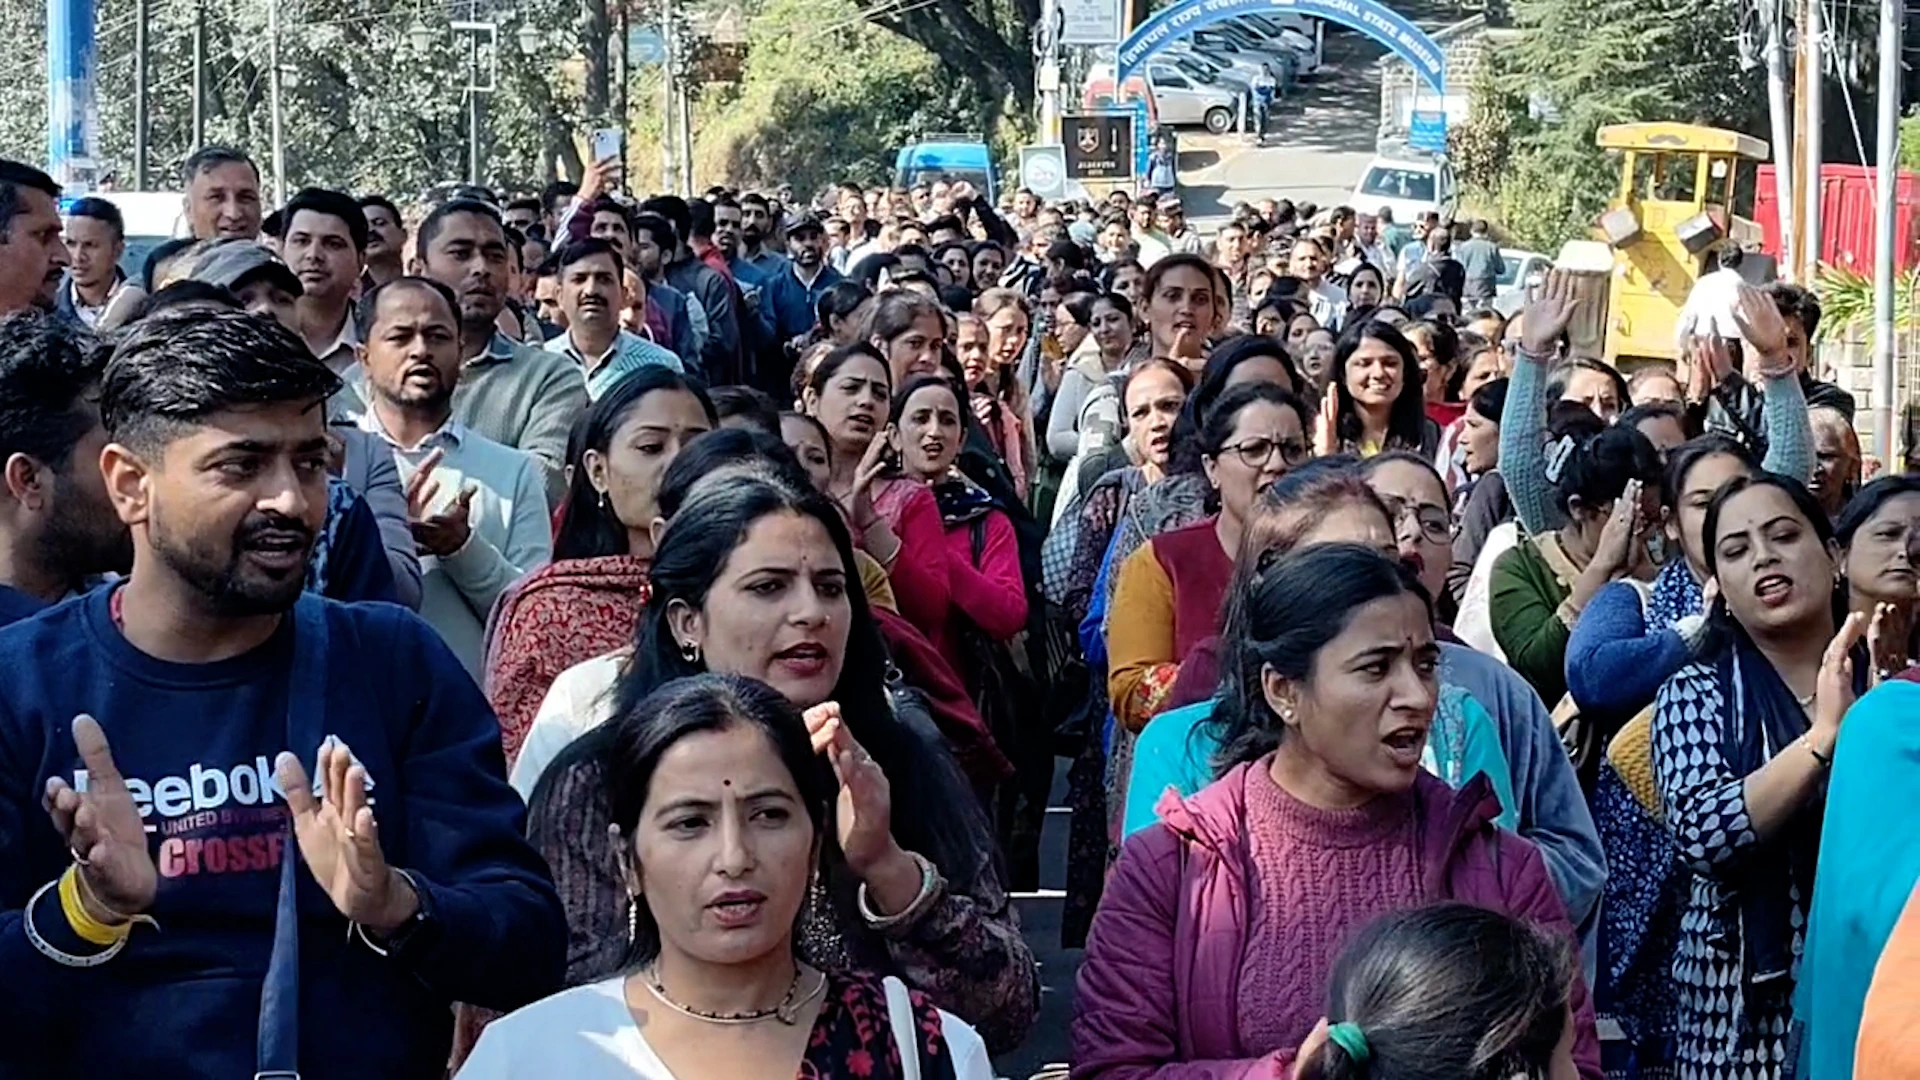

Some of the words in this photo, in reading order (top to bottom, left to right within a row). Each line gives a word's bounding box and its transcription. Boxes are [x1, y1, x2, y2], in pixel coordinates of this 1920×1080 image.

[1363, 11, 1399, 39] STATE
[1397, 32, 1441, 75] MUSEUM
[74, 756, 288, 817] eebok
[161, 810, 217, 835] UNITED
[159, 834, 283, 877] CrossF
